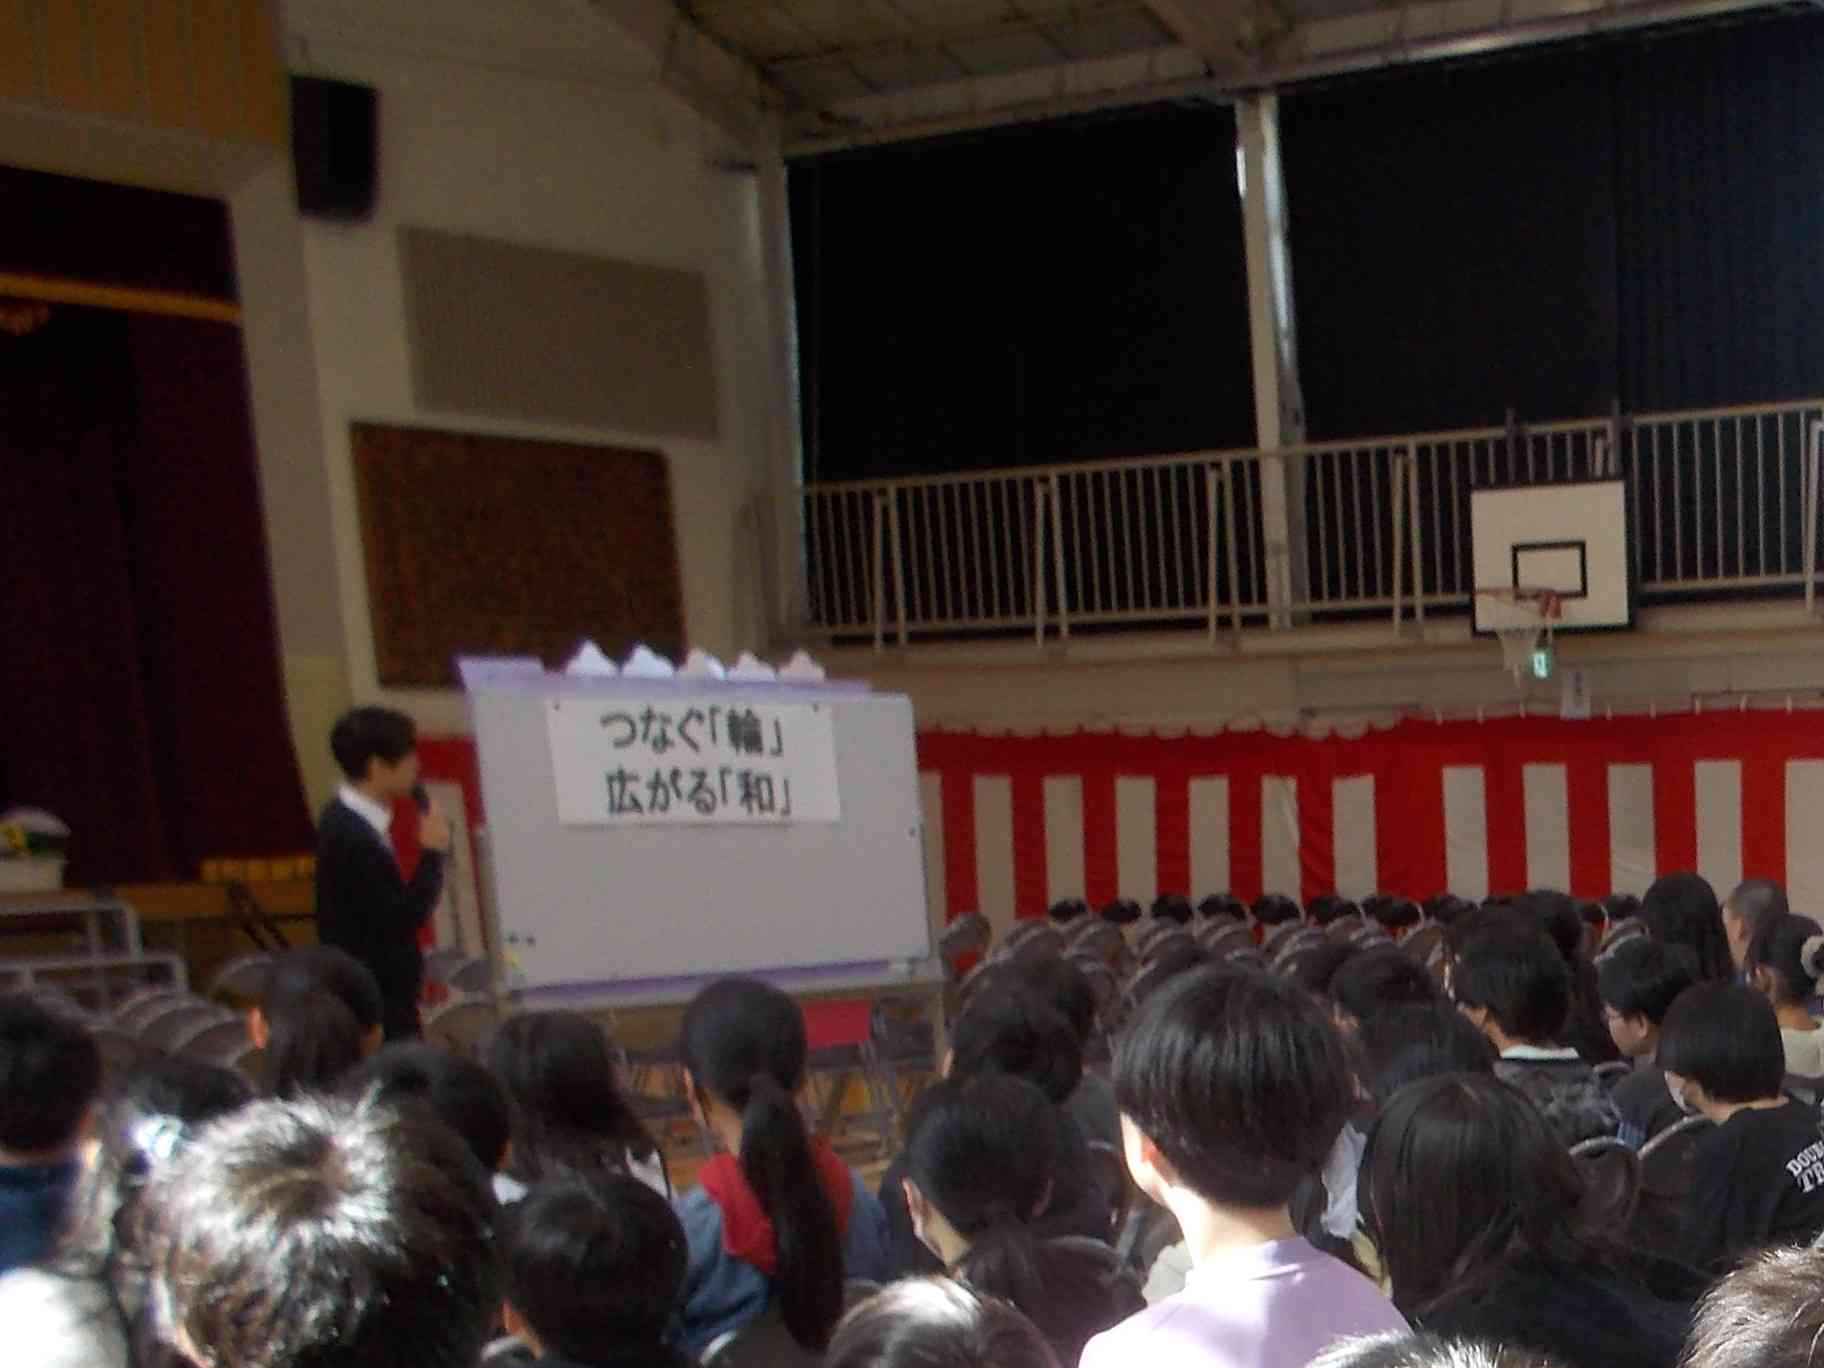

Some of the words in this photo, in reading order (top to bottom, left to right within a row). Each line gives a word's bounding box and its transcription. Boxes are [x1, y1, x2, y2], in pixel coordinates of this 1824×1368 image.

[599, 703, 784, 757] つなぐ「輪」
[605, 765, 792, 816] 広がる「和」
